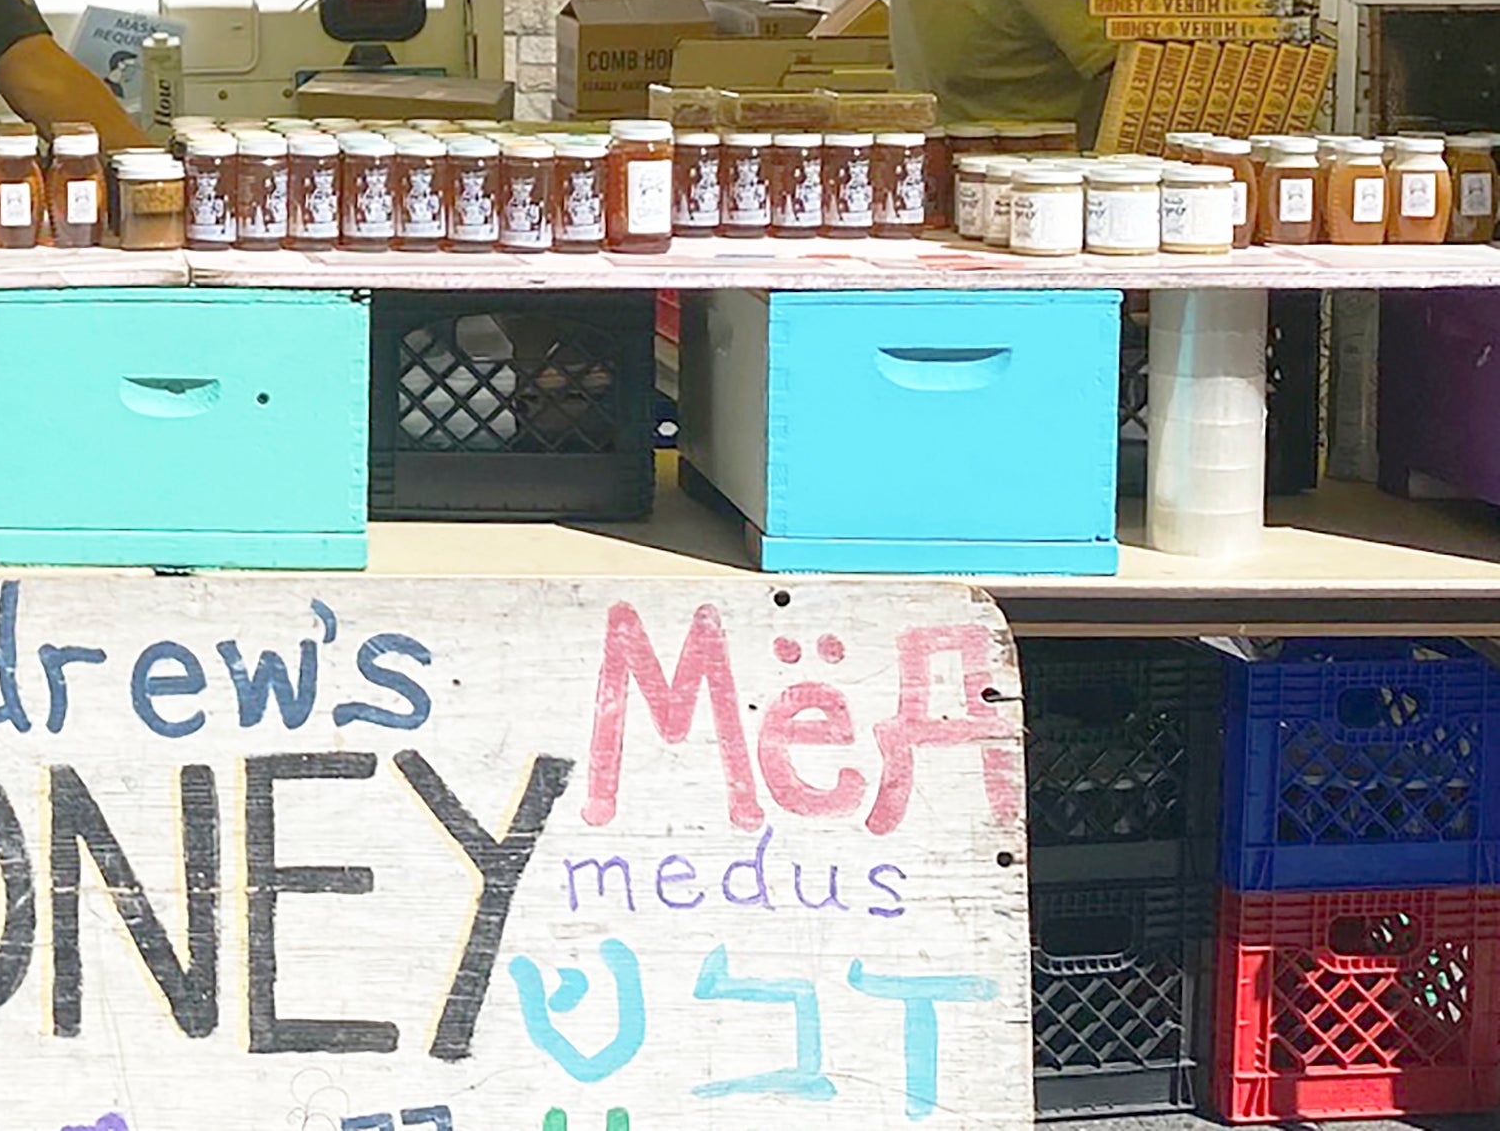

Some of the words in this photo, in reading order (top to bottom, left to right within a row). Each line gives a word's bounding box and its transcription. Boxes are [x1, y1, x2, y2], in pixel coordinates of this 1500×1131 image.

[587, 50, 638, 72] COMB
[563, 824, 907, 918] medus
[508, 939, 1002, 1122] דבש
